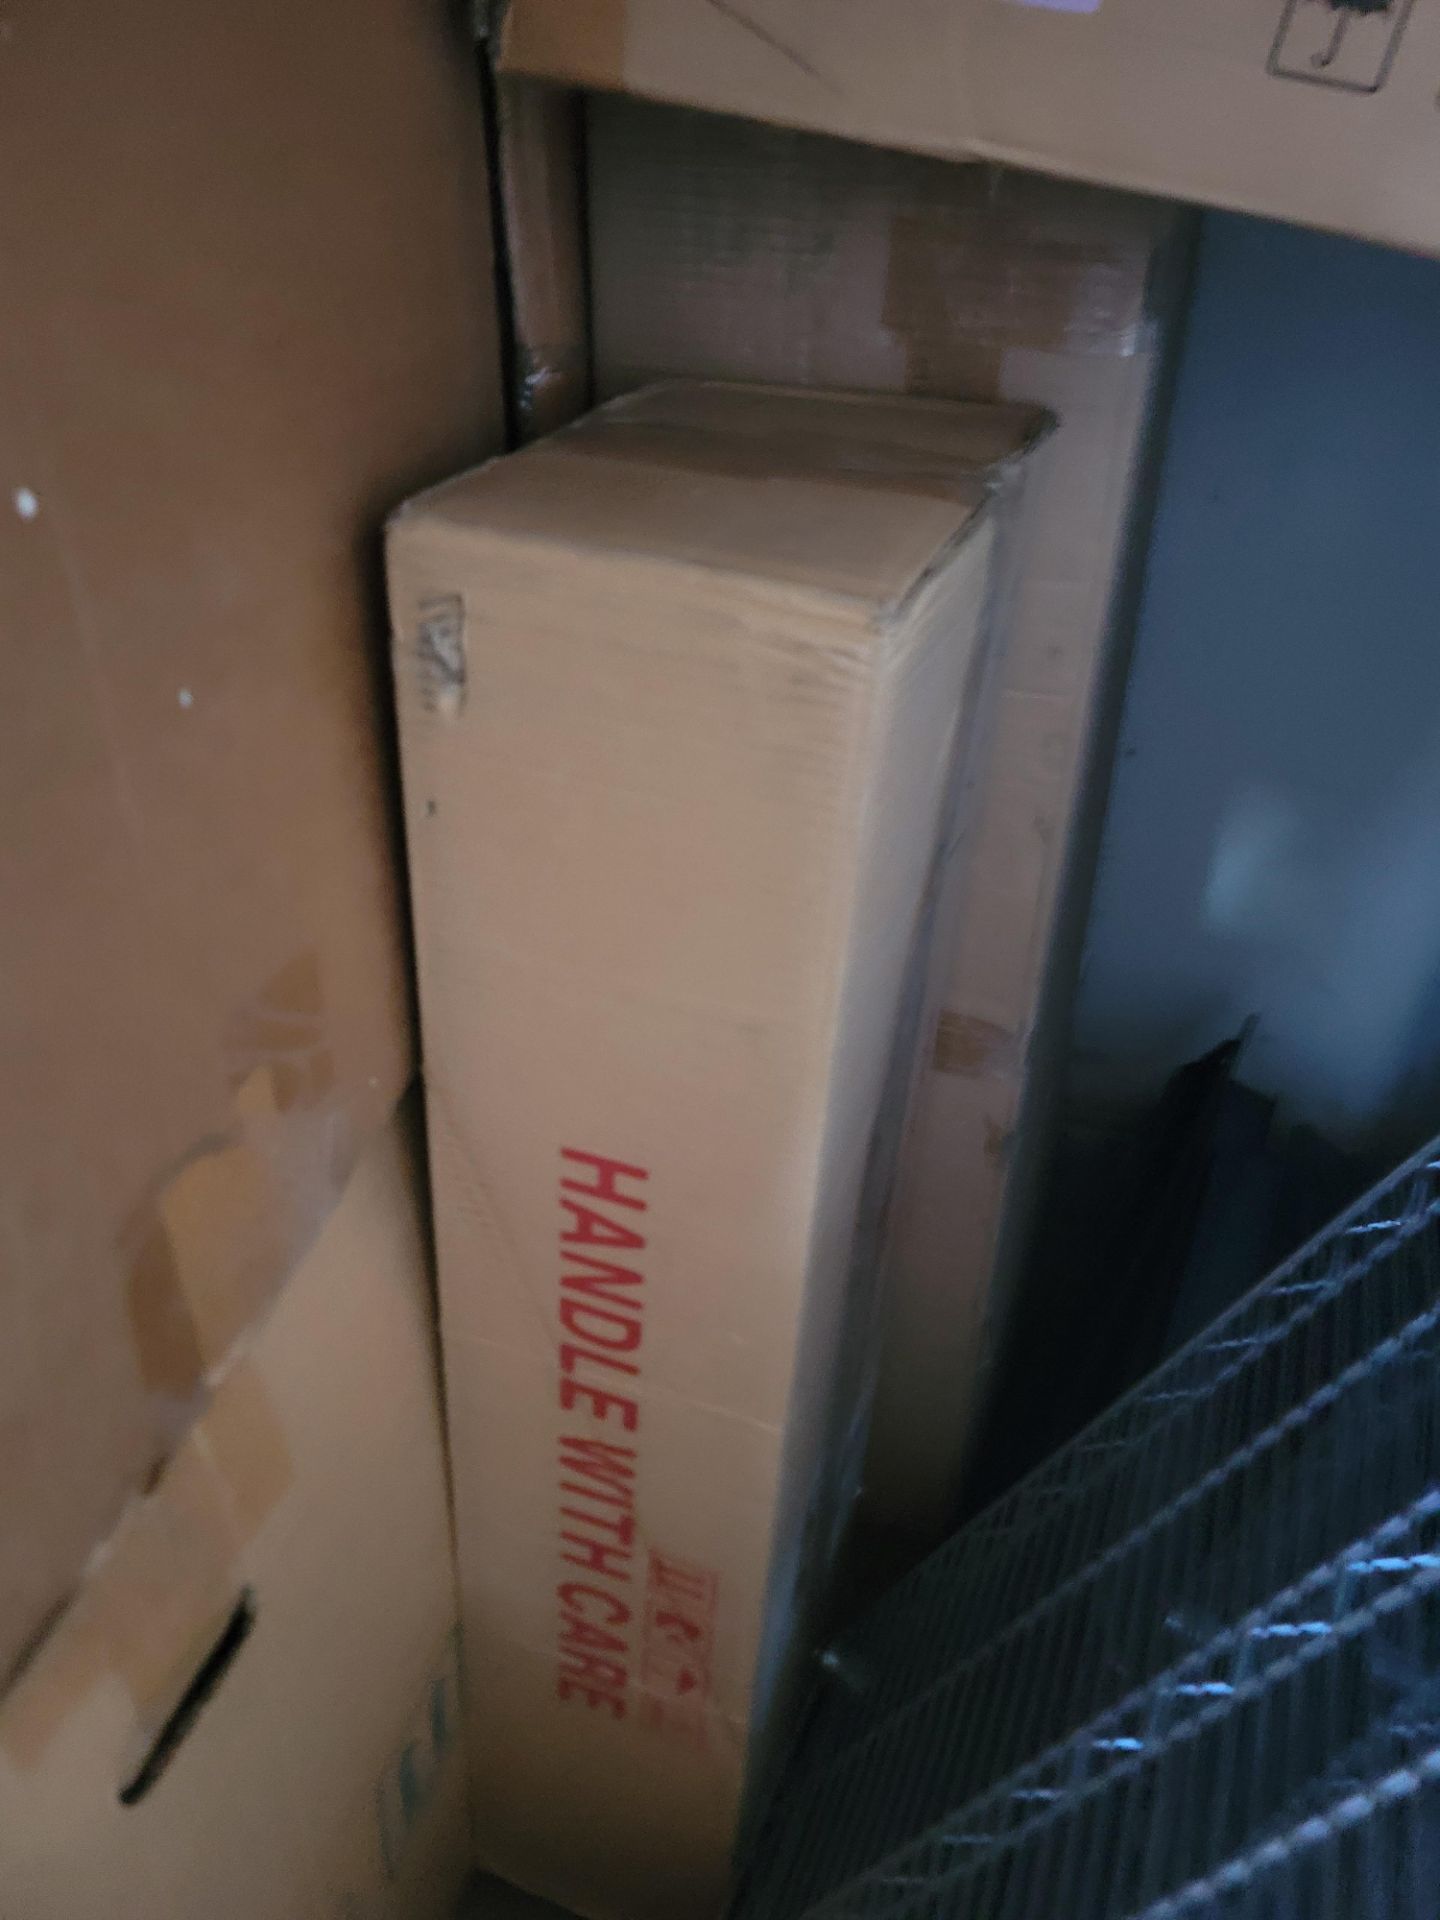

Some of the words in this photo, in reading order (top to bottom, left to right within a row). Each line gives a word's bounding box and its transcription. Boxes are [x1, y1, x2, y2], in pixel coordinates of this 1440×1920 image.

[559, 1146, 649, 1432] HANDLE
[558, 1436, 638, 1581] WITH
[557, 1582, 632, 1720] CARE
